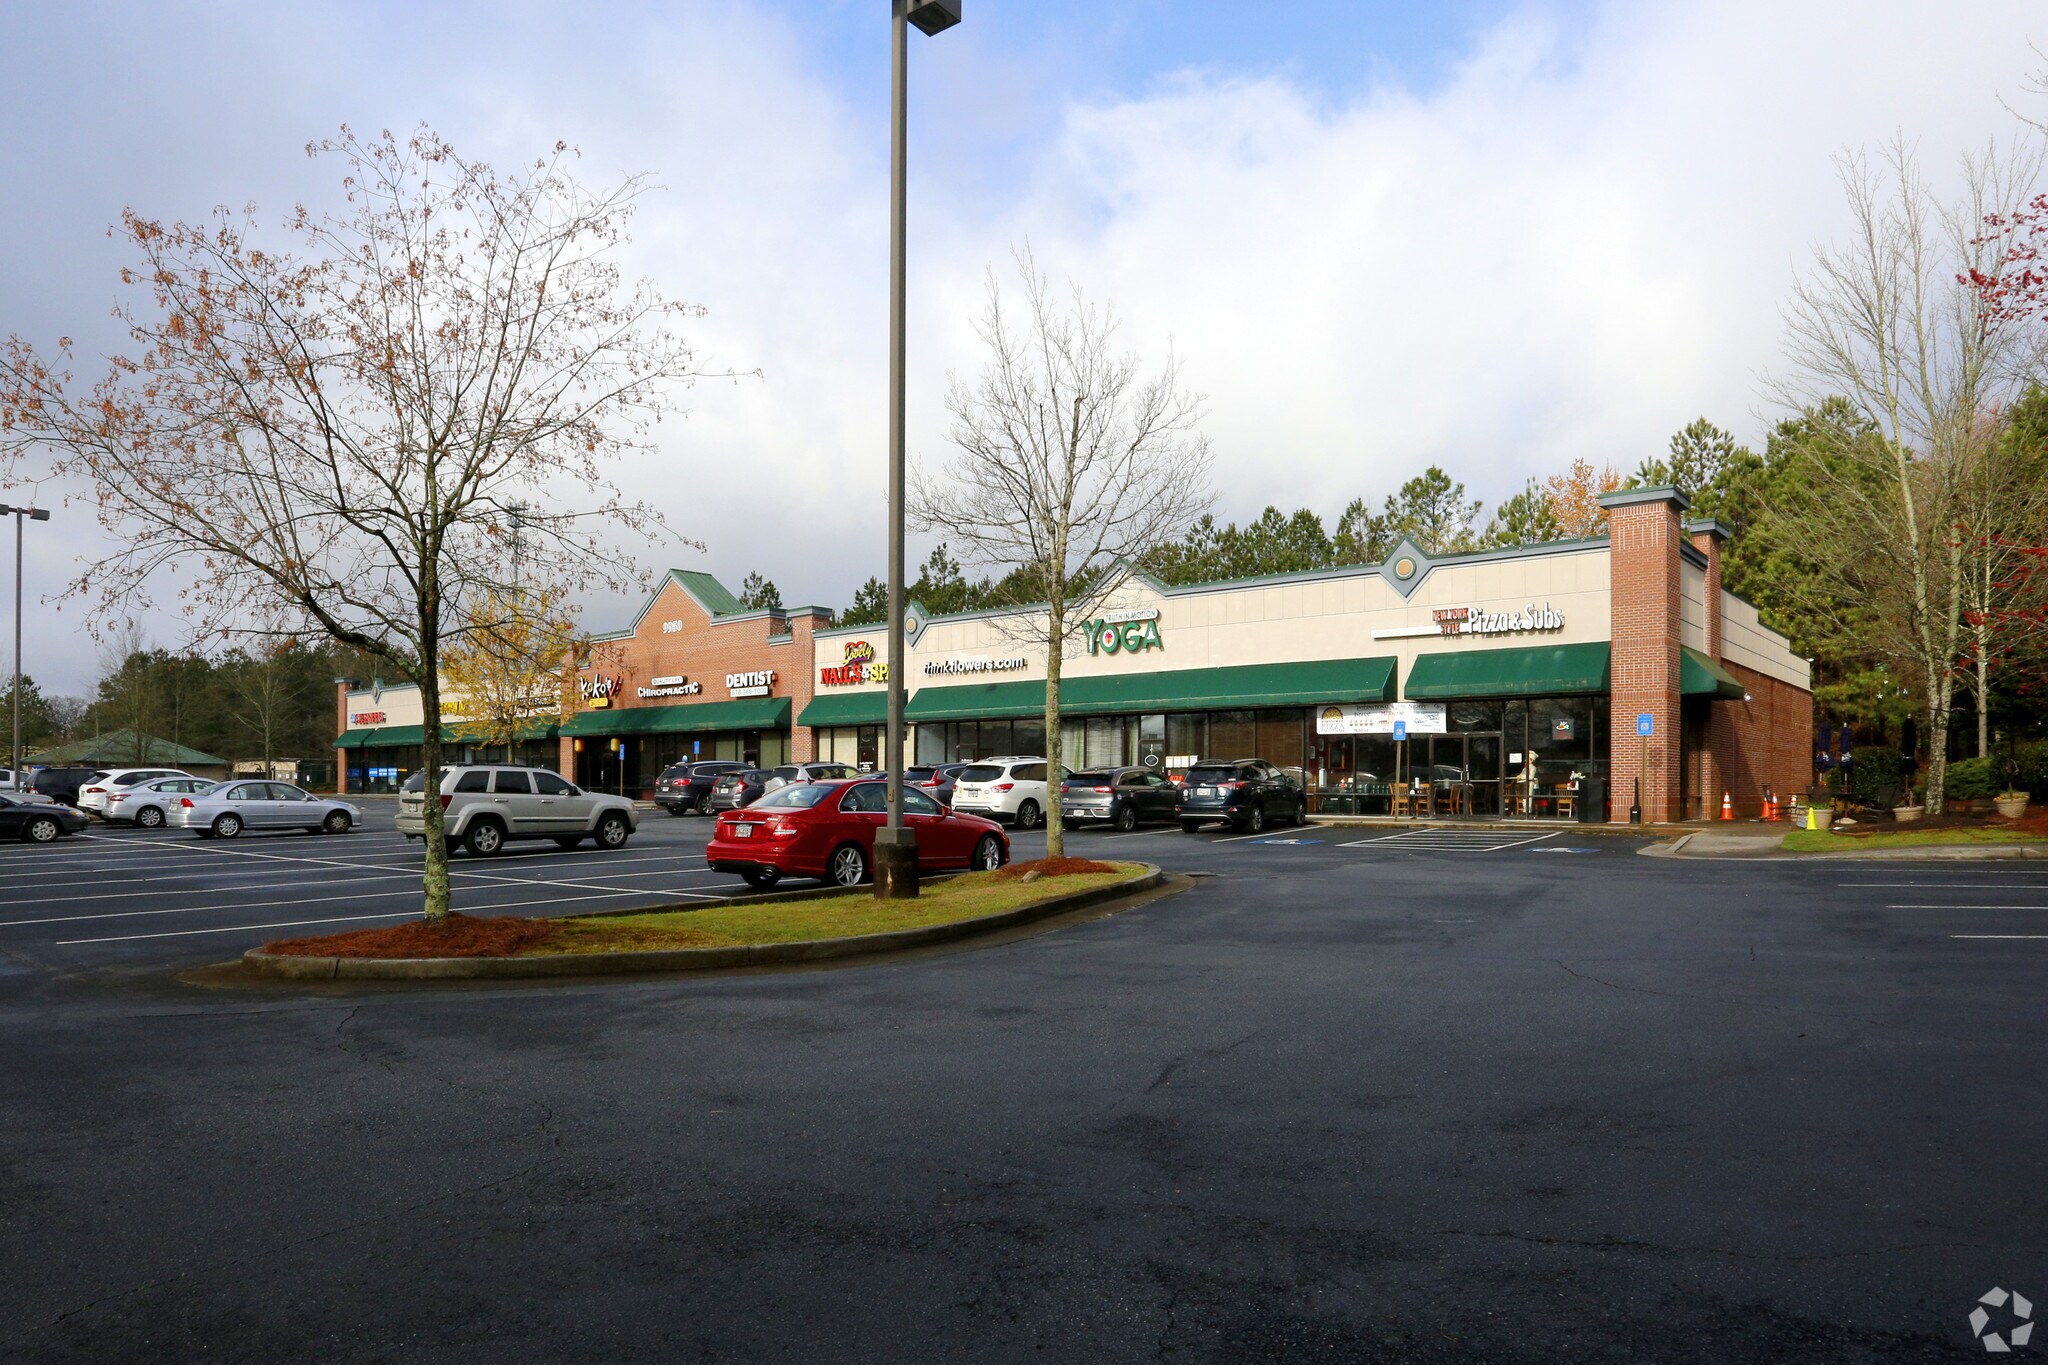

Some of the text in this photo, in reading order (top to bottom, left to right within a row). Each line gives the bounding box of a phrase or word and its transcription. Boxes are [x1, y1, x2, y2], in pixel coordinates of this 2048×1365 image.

[1449, 607, 1469, 620] YORK
[1468, 602, 1563, 633] Pizza & Subs
[1082, 618, 1162, 654] YOGA
[726, 670, 773, 688] DENTIST
[821, 664, 889, 684] NAILS & SP
